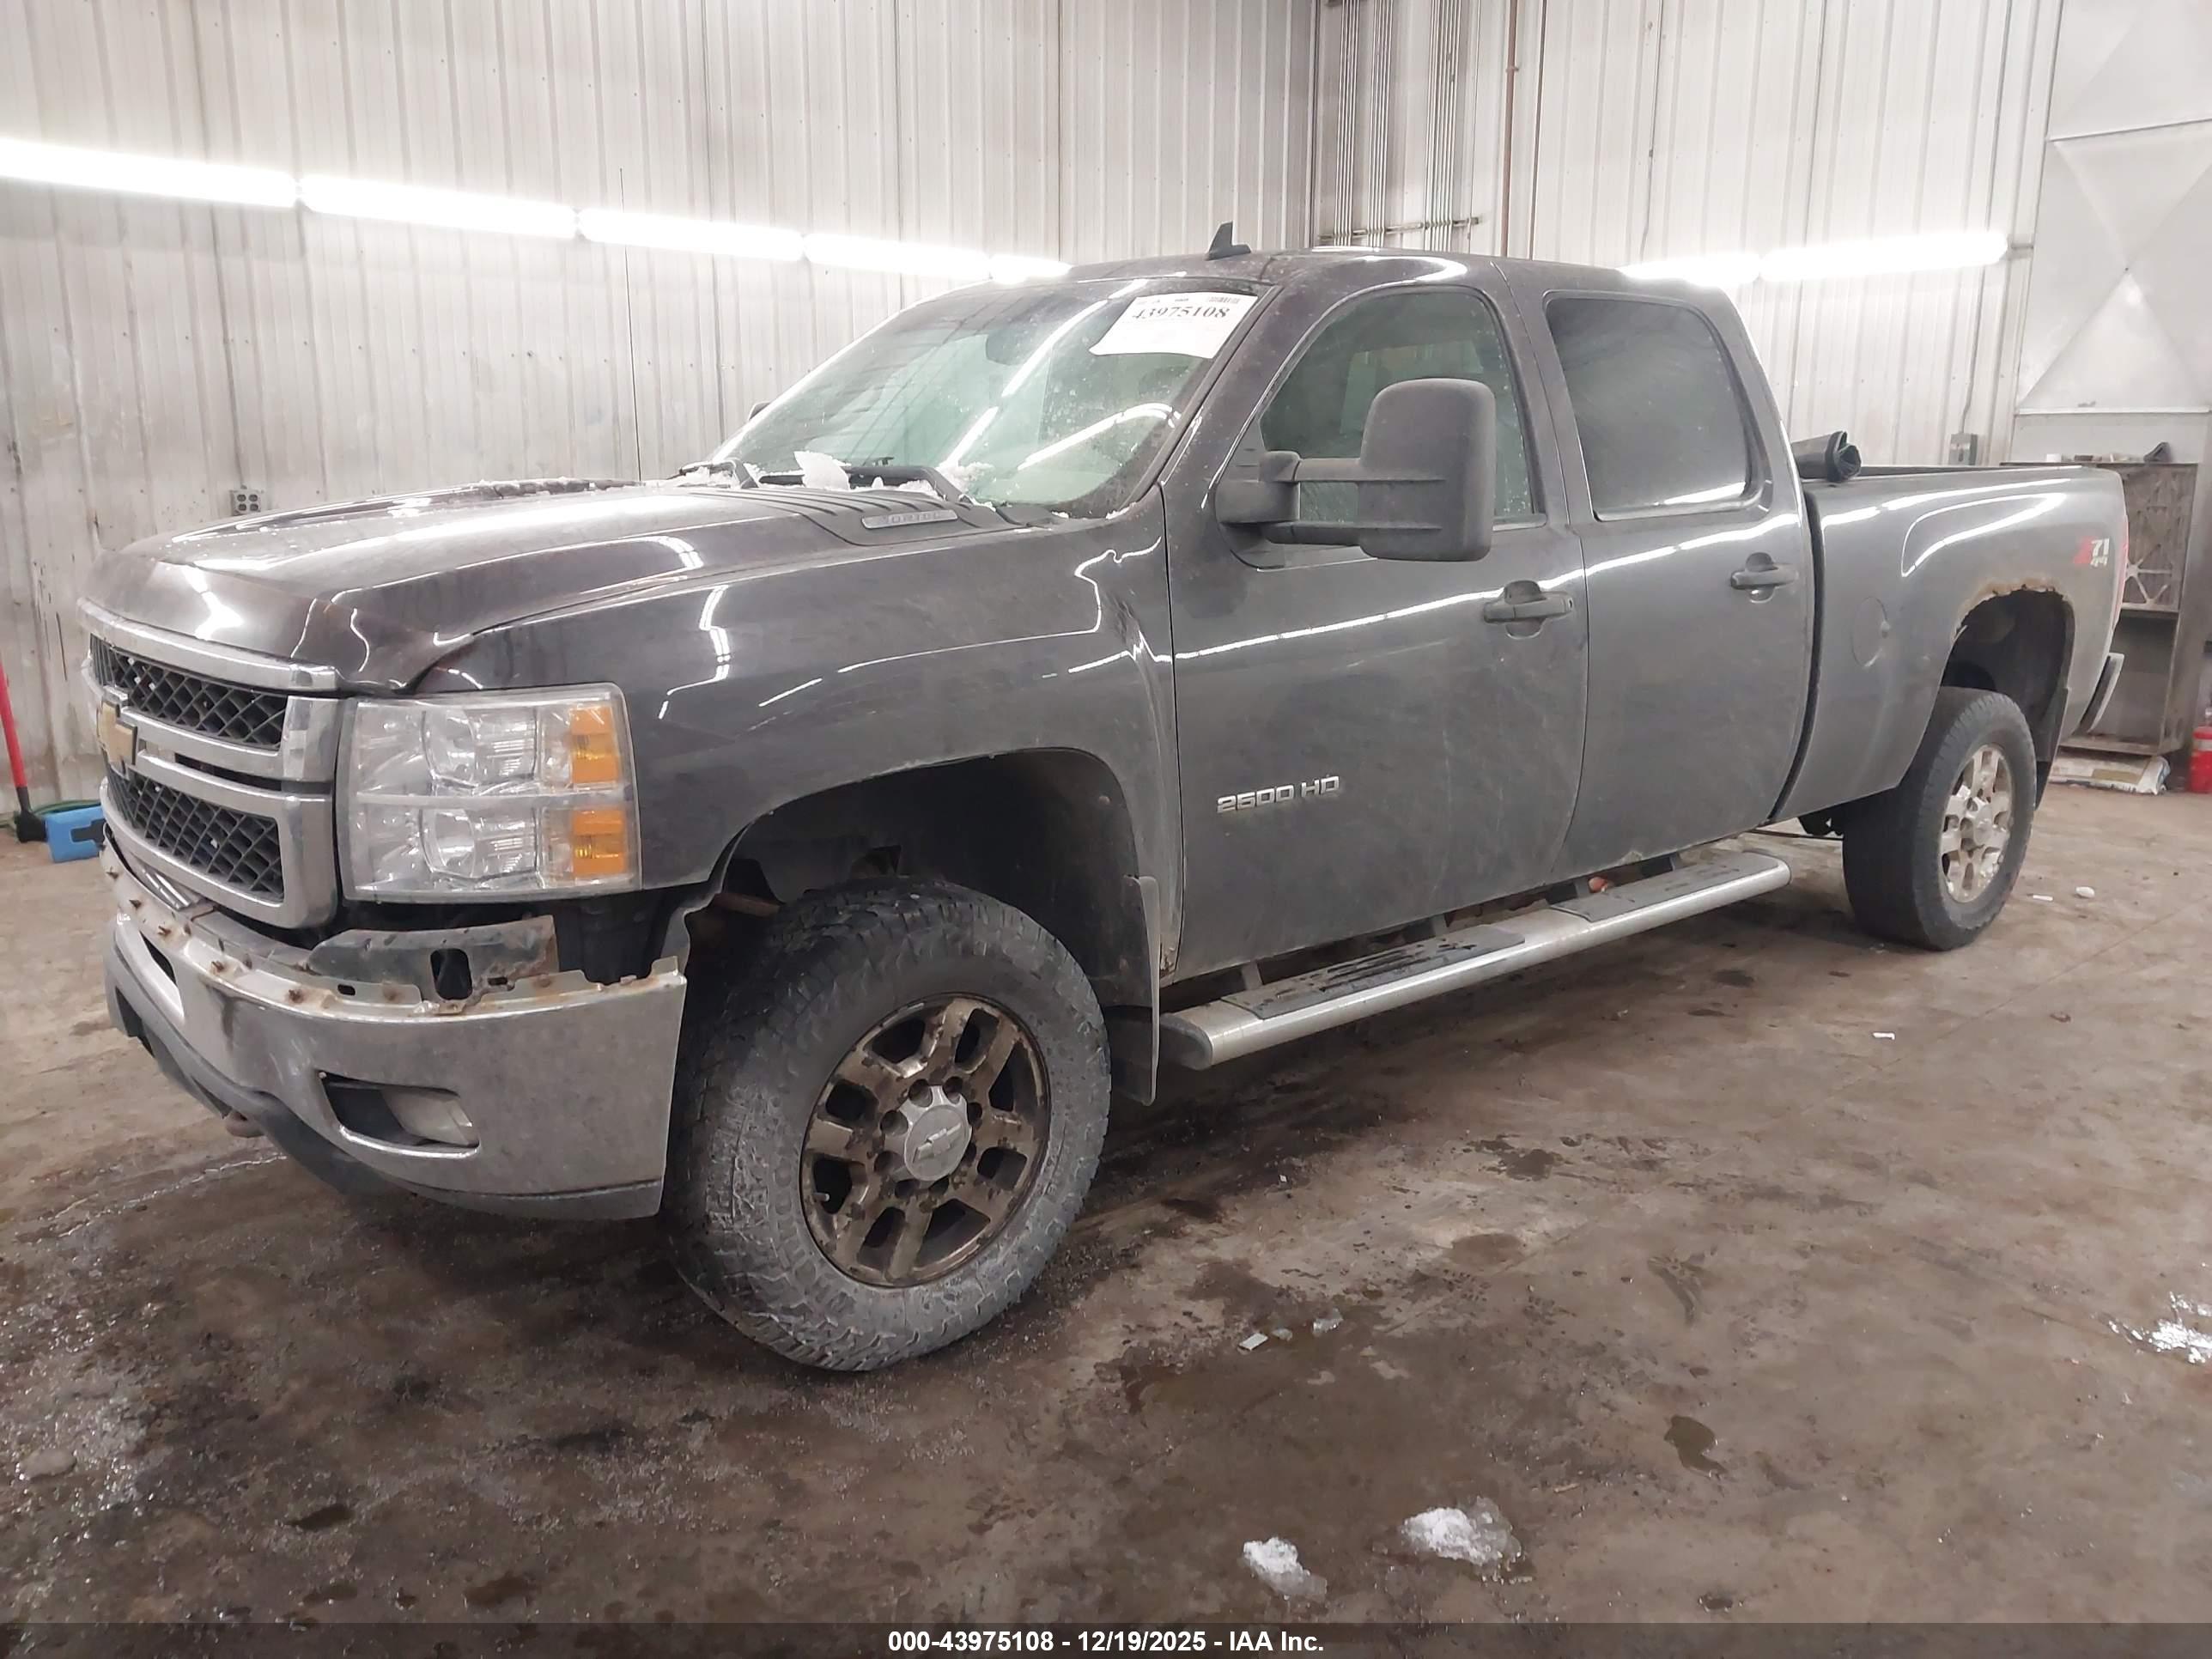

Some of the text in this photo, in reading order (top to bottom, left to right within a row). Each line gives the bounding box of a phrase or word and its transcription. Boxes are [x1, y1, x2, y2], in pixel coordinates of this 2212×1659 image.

[1132, 306, 1231, 320] 43975108
[1217, 775, 1340, 813] 2500 HD
